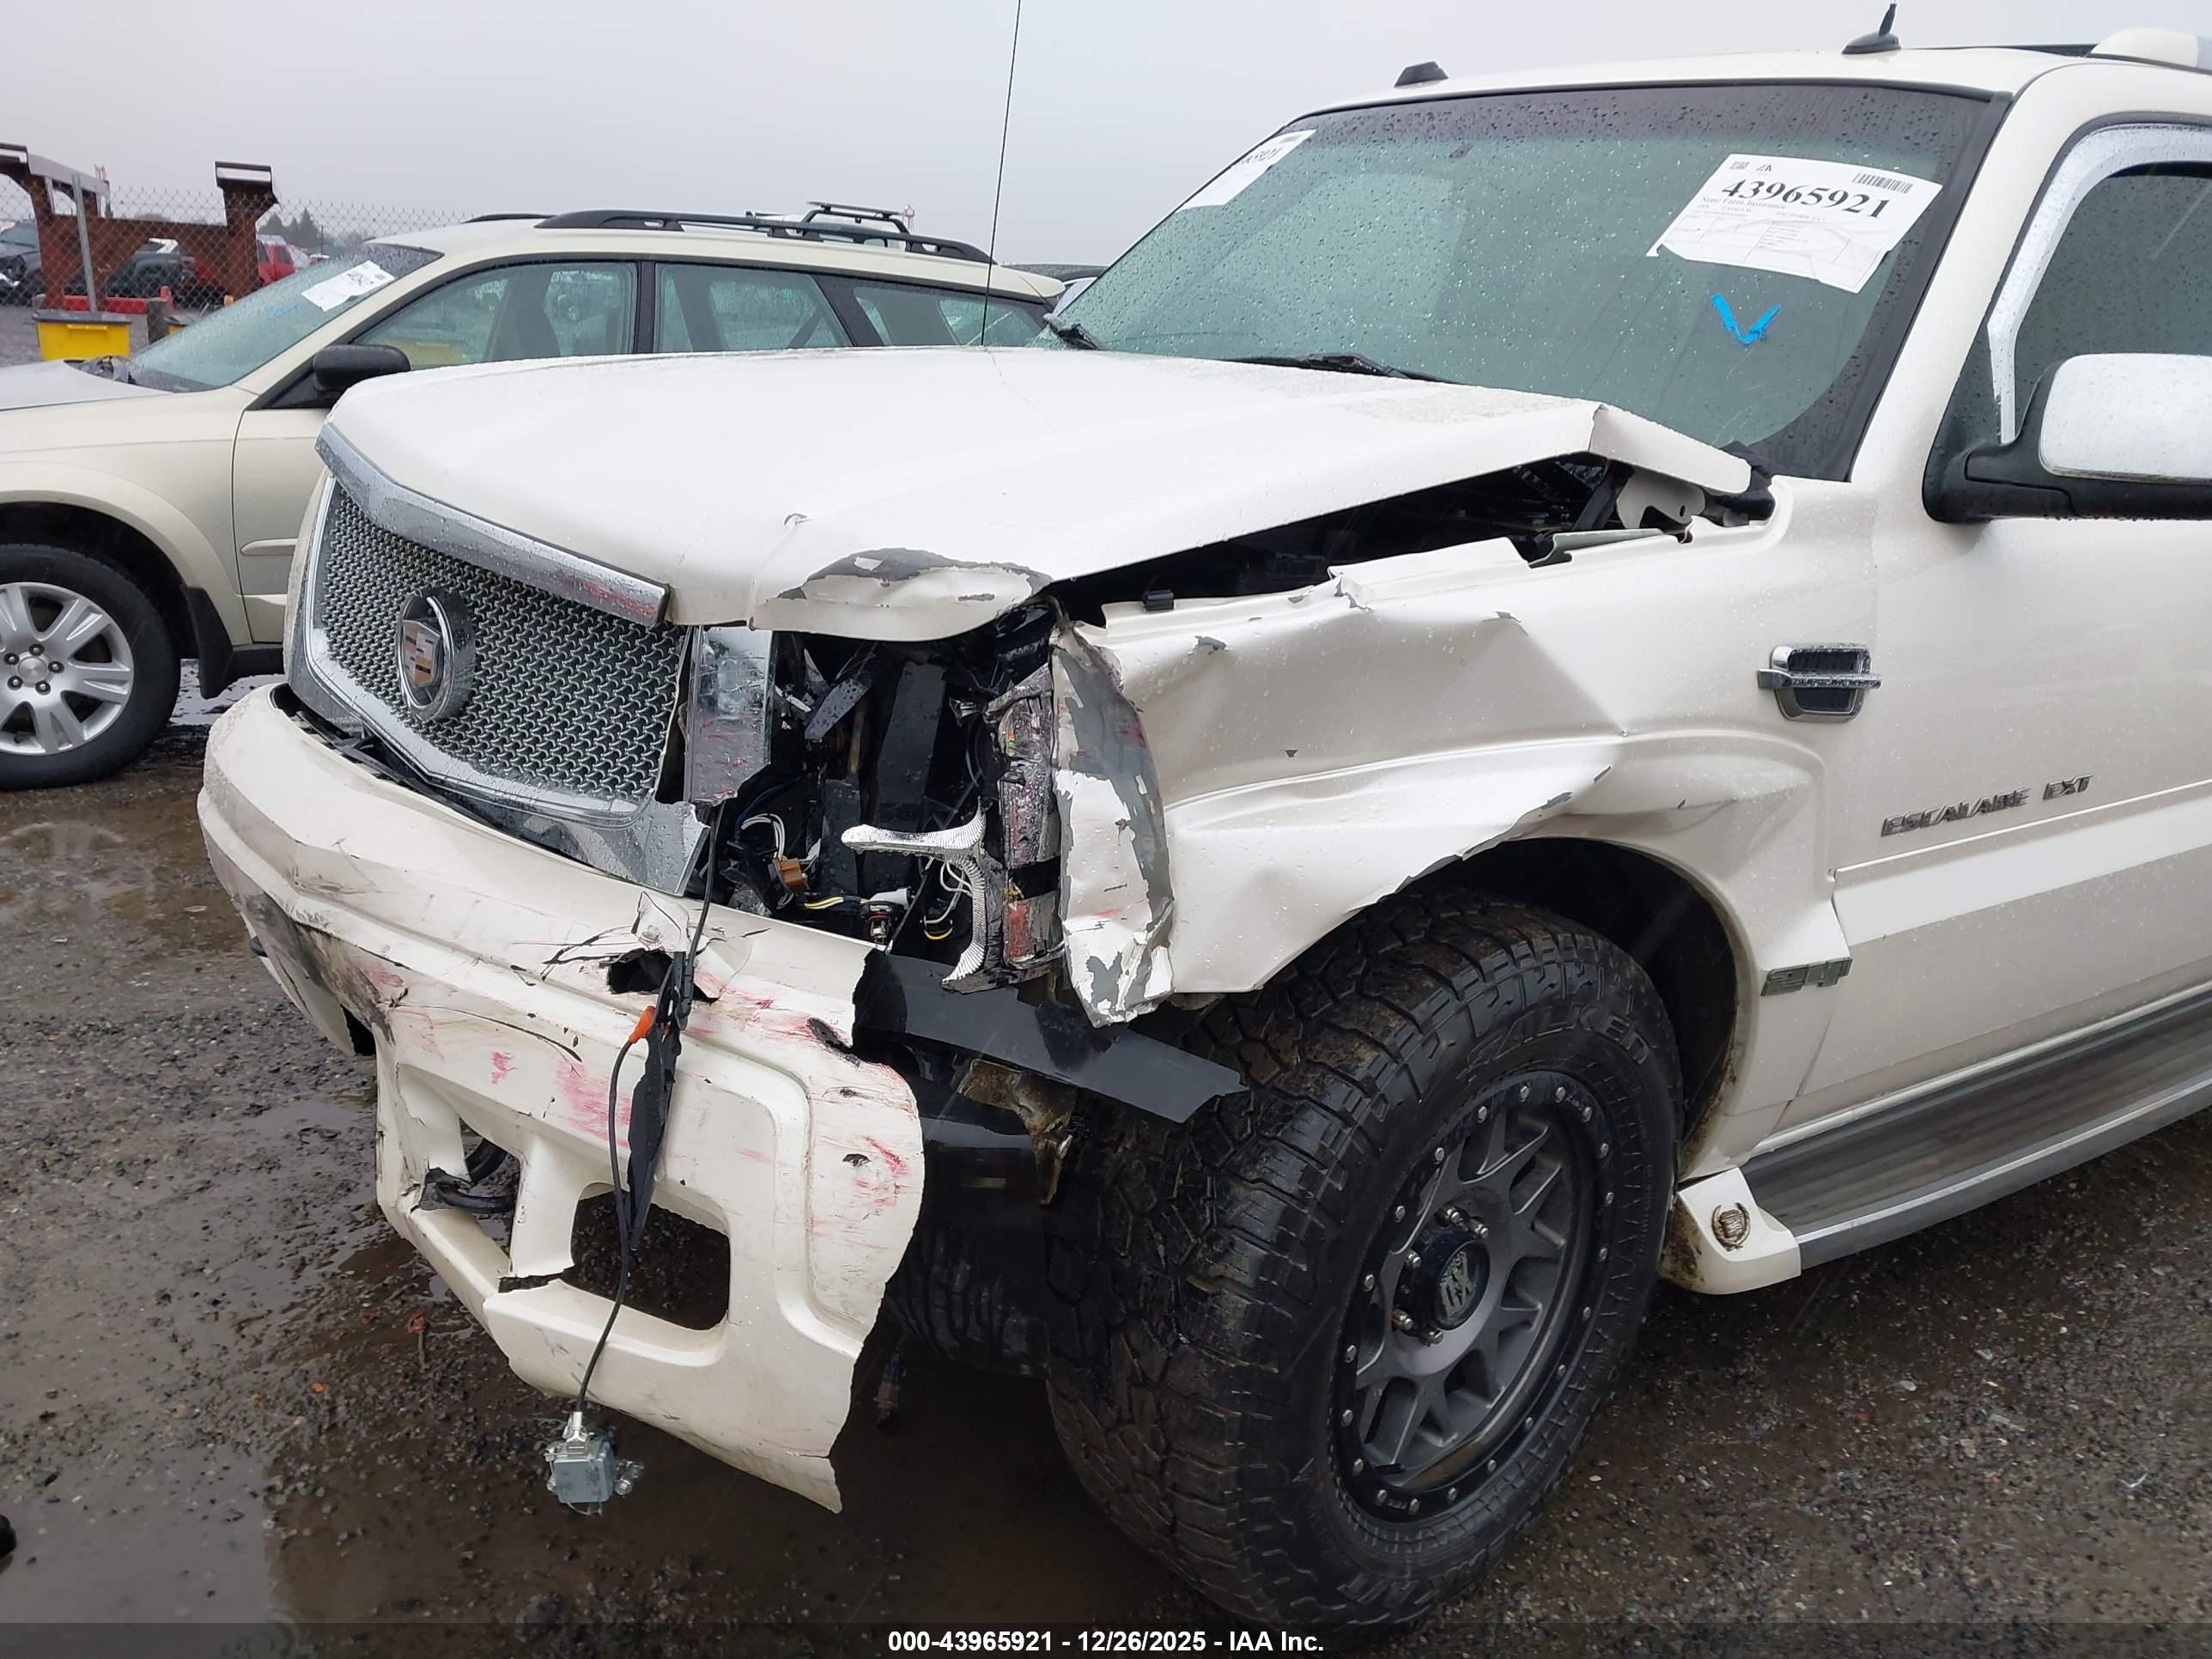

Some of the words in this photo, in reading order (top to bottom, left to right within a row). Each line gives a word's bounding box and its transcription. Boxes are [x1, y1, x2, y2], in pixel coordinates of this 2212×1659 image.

[1721, 178, 1890, 219] 43965921
[1881, 786, 2032, 838] ESCALADE
[2042, 773, 2095, 801] EXT
